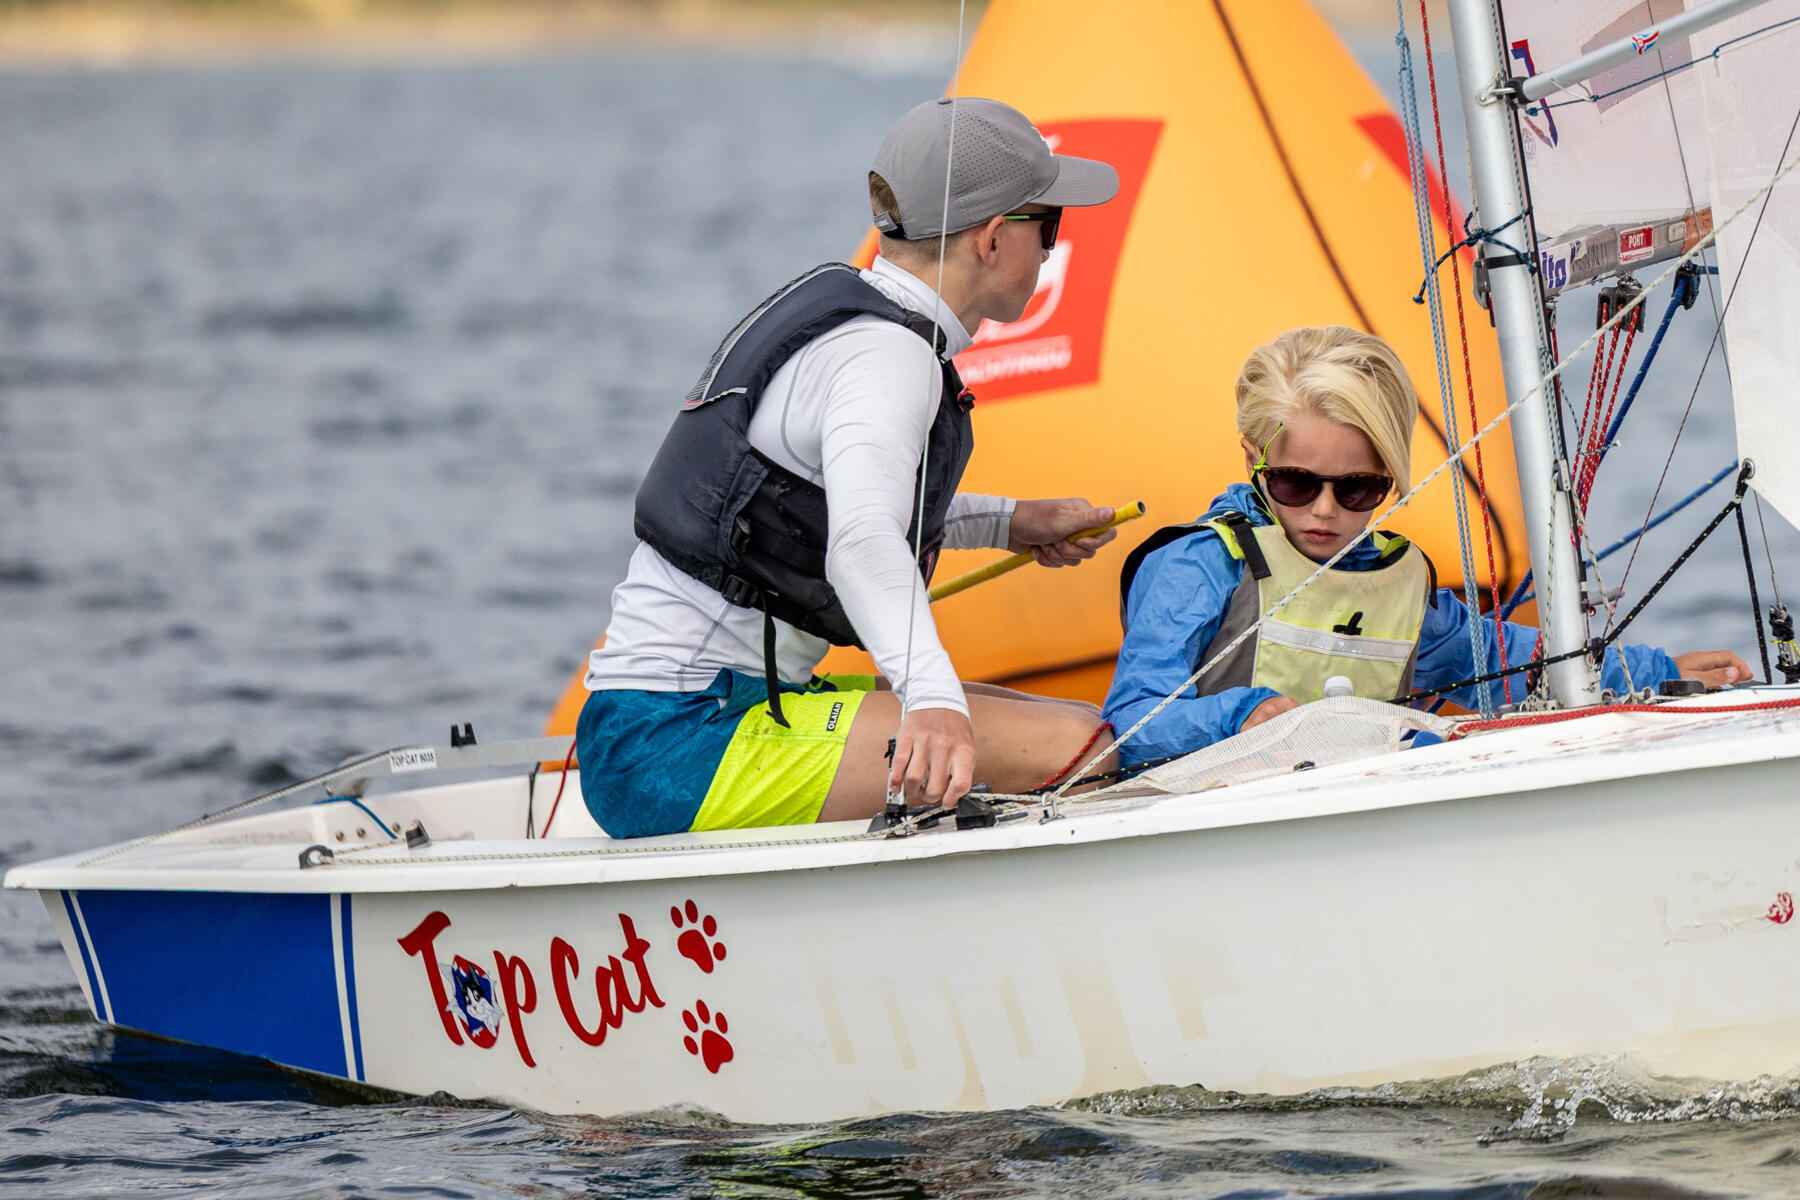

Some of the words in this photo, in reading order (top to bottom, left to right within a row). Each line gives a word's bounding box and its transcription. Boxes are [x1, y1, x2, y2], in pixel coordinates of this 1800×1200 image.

[1628, 233, 1644, 248] PORT
[827, 702, 842, 730] OLAIAN
[390, 753, 404, 768] TOP
[405, 752, 418, 766] CAT
[397, 910, 537, 1069] Top
[550, 912, 666, 1047] Cat
